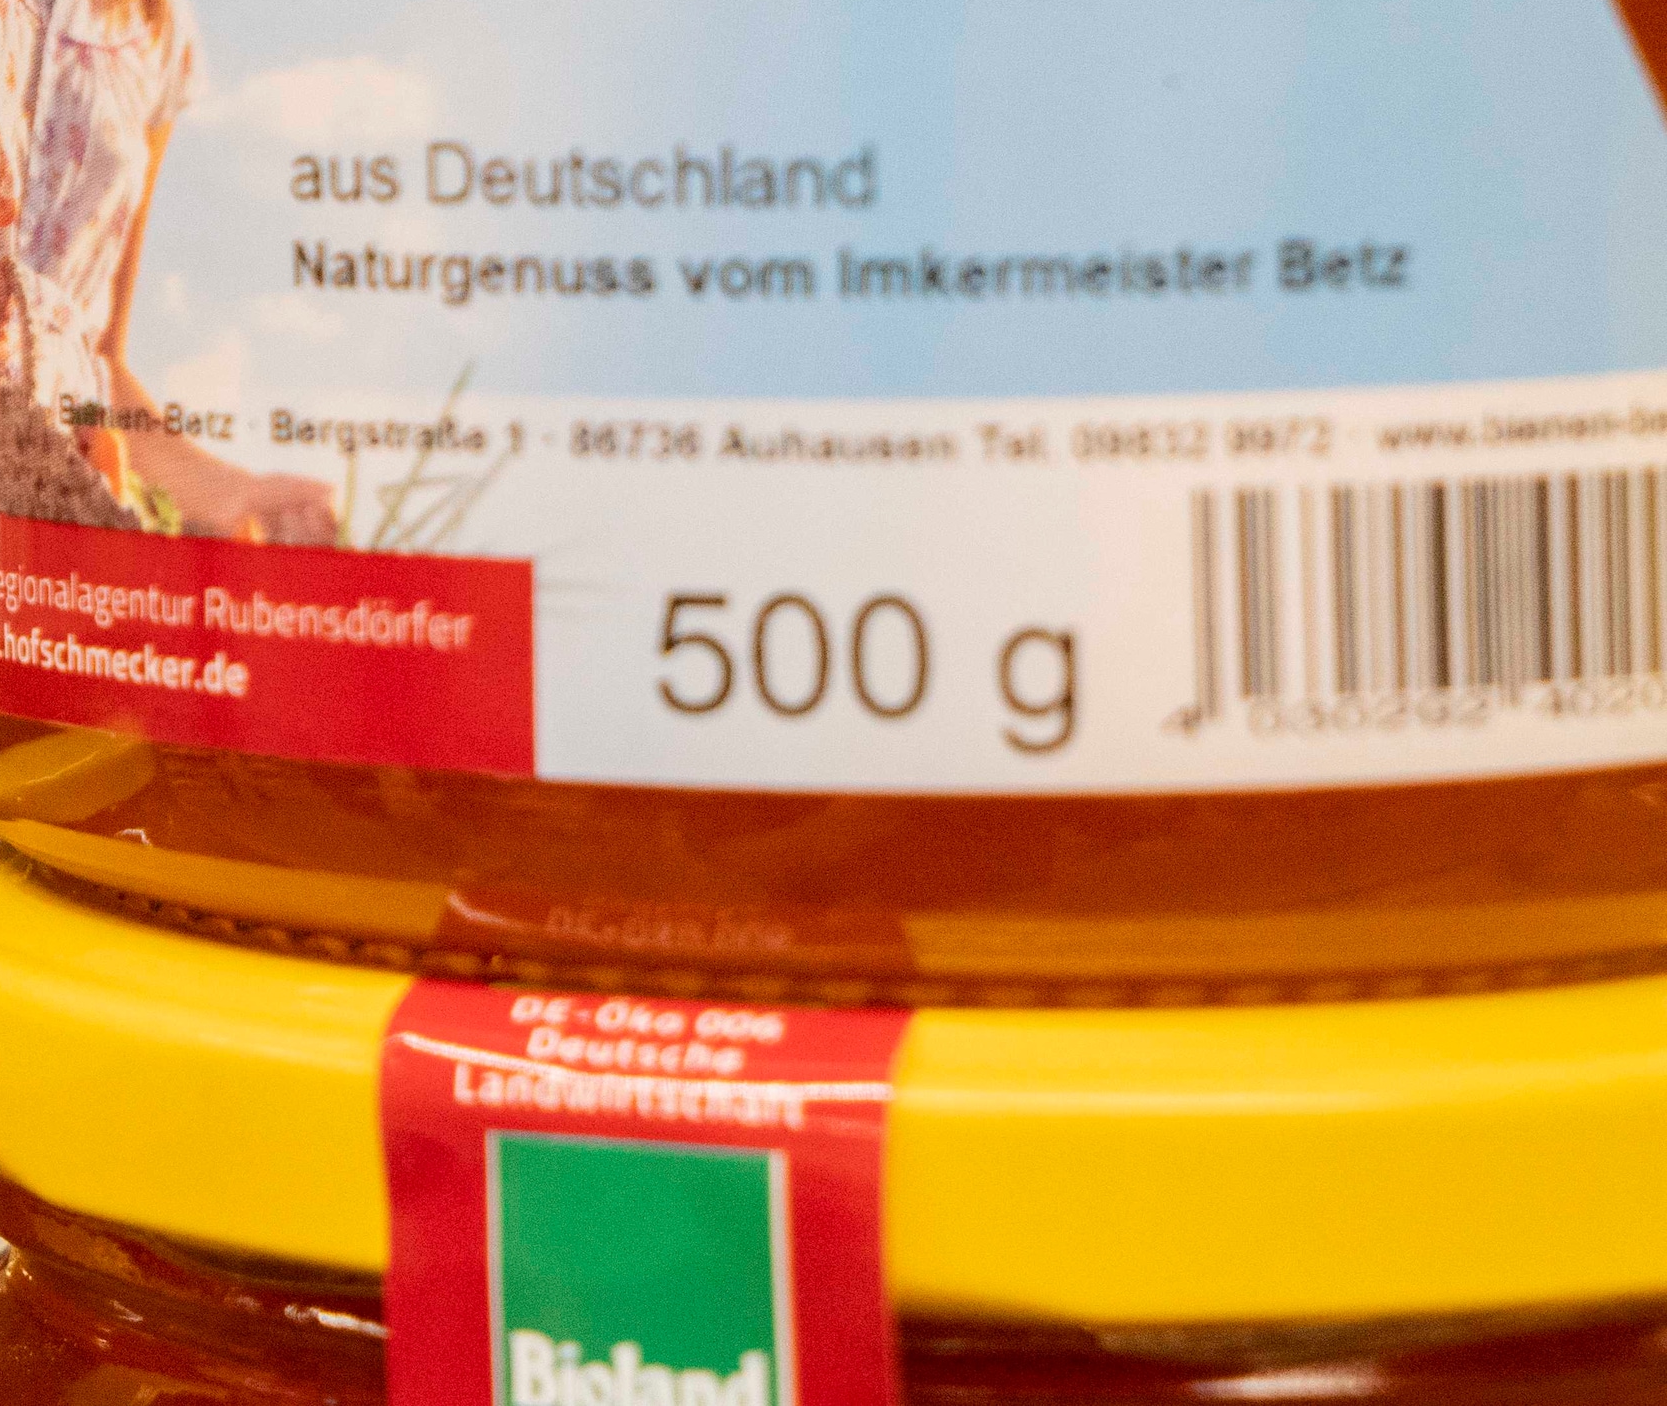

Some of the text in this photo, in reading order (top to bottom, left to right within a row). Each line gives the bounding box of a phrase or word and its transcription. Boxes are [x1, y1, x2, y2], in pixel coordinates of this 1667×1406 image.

[290, 140, 881, 210] aus Deutschland
[291, 234, 1412, 305] Naturgenuss vom Imkermeister Betz
[203, 586, 476, 650] Rubensdörfer
[657, 591, 1077, 757] 500 g
[510, 995, 685, 1037] DE-Öko
[527, 1026, 745, 1078] Deutsche
[451, 1062, 806, 1131] Landwirtschaft
[509, 1327, 769, 1406] Bioland
